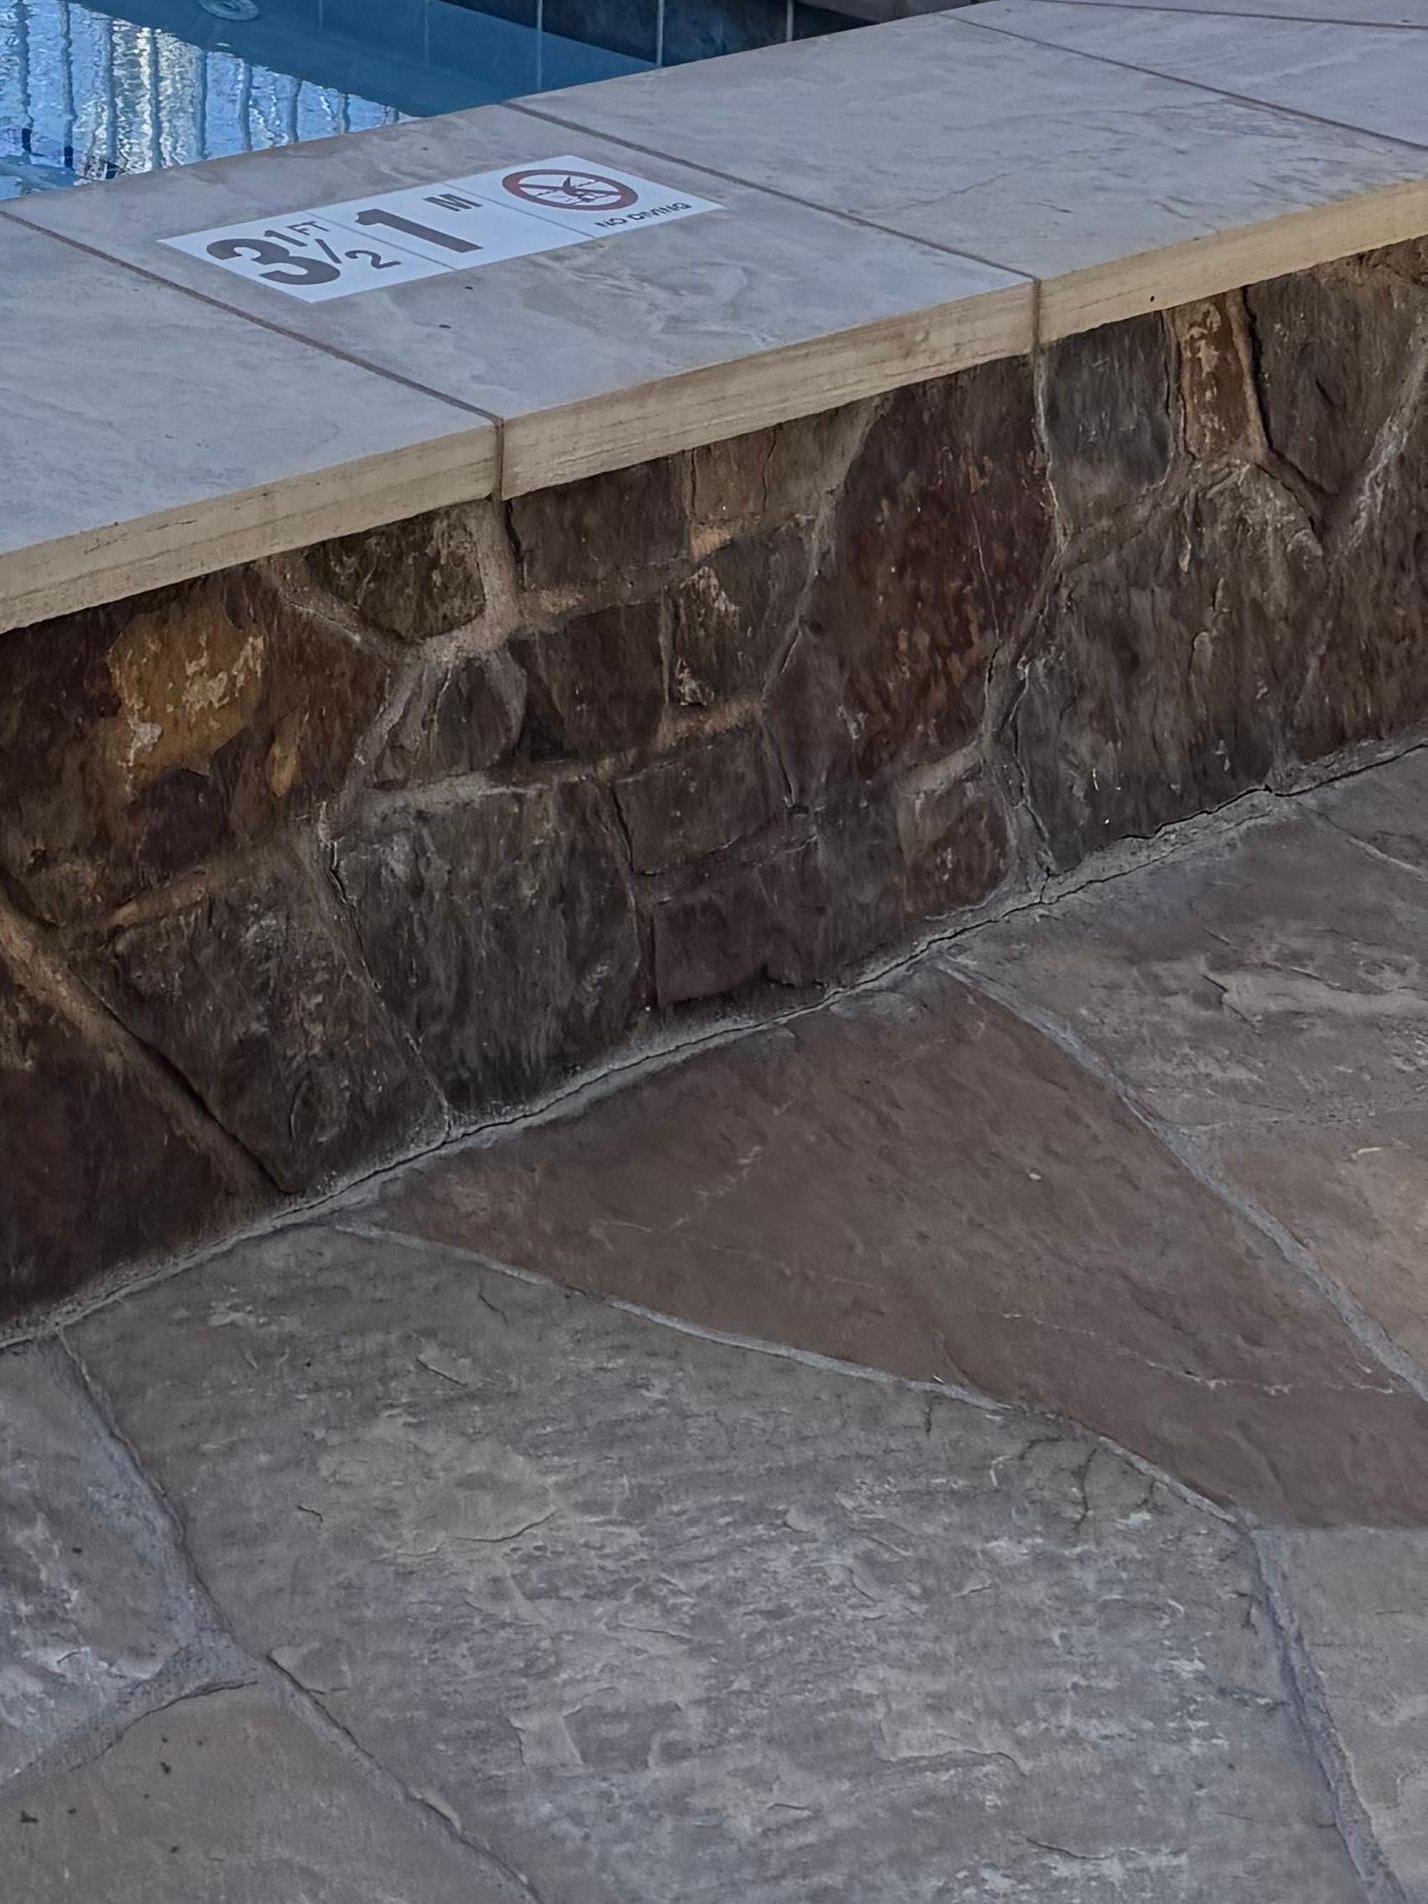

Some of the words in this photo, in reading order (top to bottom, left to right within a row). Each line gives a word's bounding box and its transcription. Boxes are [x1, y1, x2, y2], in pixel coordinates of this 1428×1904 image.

[285, 217, 335, 234] FT
[354, 208, 484, 254] 1
[422, 193, 484, 213] M
[594, 217, 628, 228] NO
[626, 201, 693, 222] DIVING
